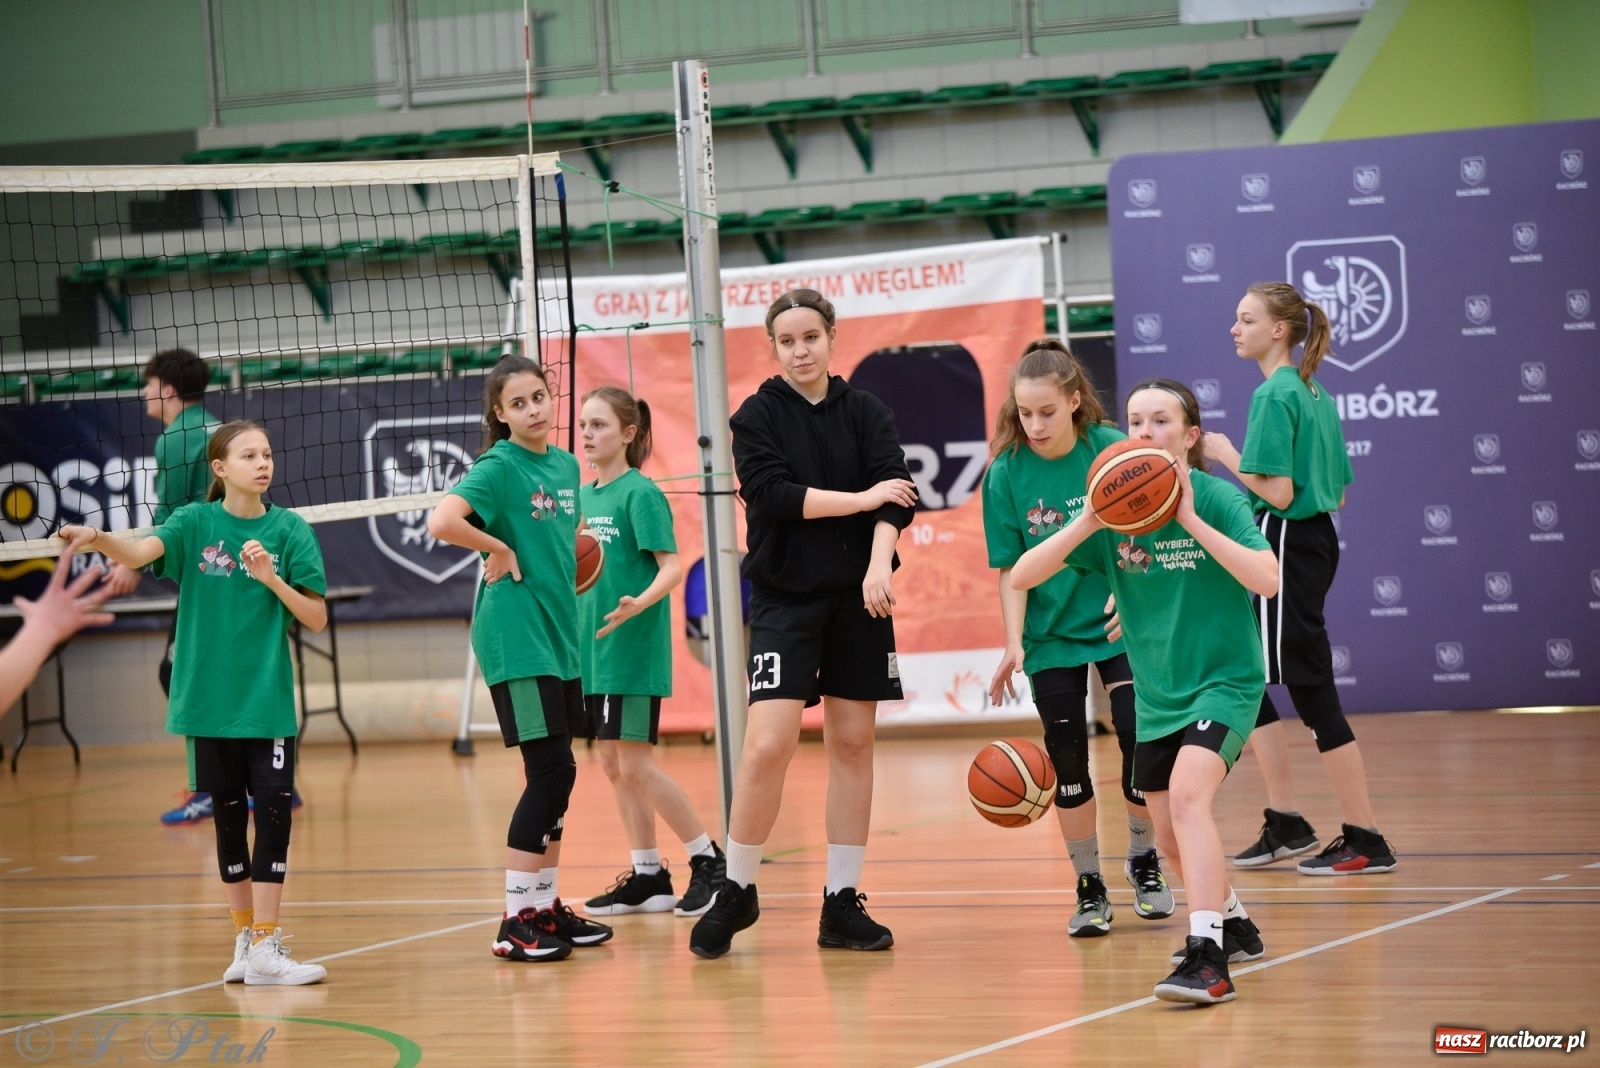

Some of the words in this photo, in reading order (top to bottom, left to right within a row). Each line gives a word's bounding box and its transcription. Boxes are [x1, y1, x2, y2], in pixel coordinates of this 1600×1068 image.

[593, 293, 649, 318] GRAJ
[656, 290, 667, 312] Z
[852, 261, 966, 299] WĘGLEM!
[1102, 462, 1152, 498] molten
[1127, 493, 1149, 511] FIBA
[912, 524, 934, 545] 10
[1154, 539, 1195, 550] WYBIERZ
[1155, 549, 1206, 563] WŁAŚCIWĄ
[751, 652, 781, 691] 23
[1067, 783, 1082, 796] NBA
[233, 862, 244, 874] NBA
